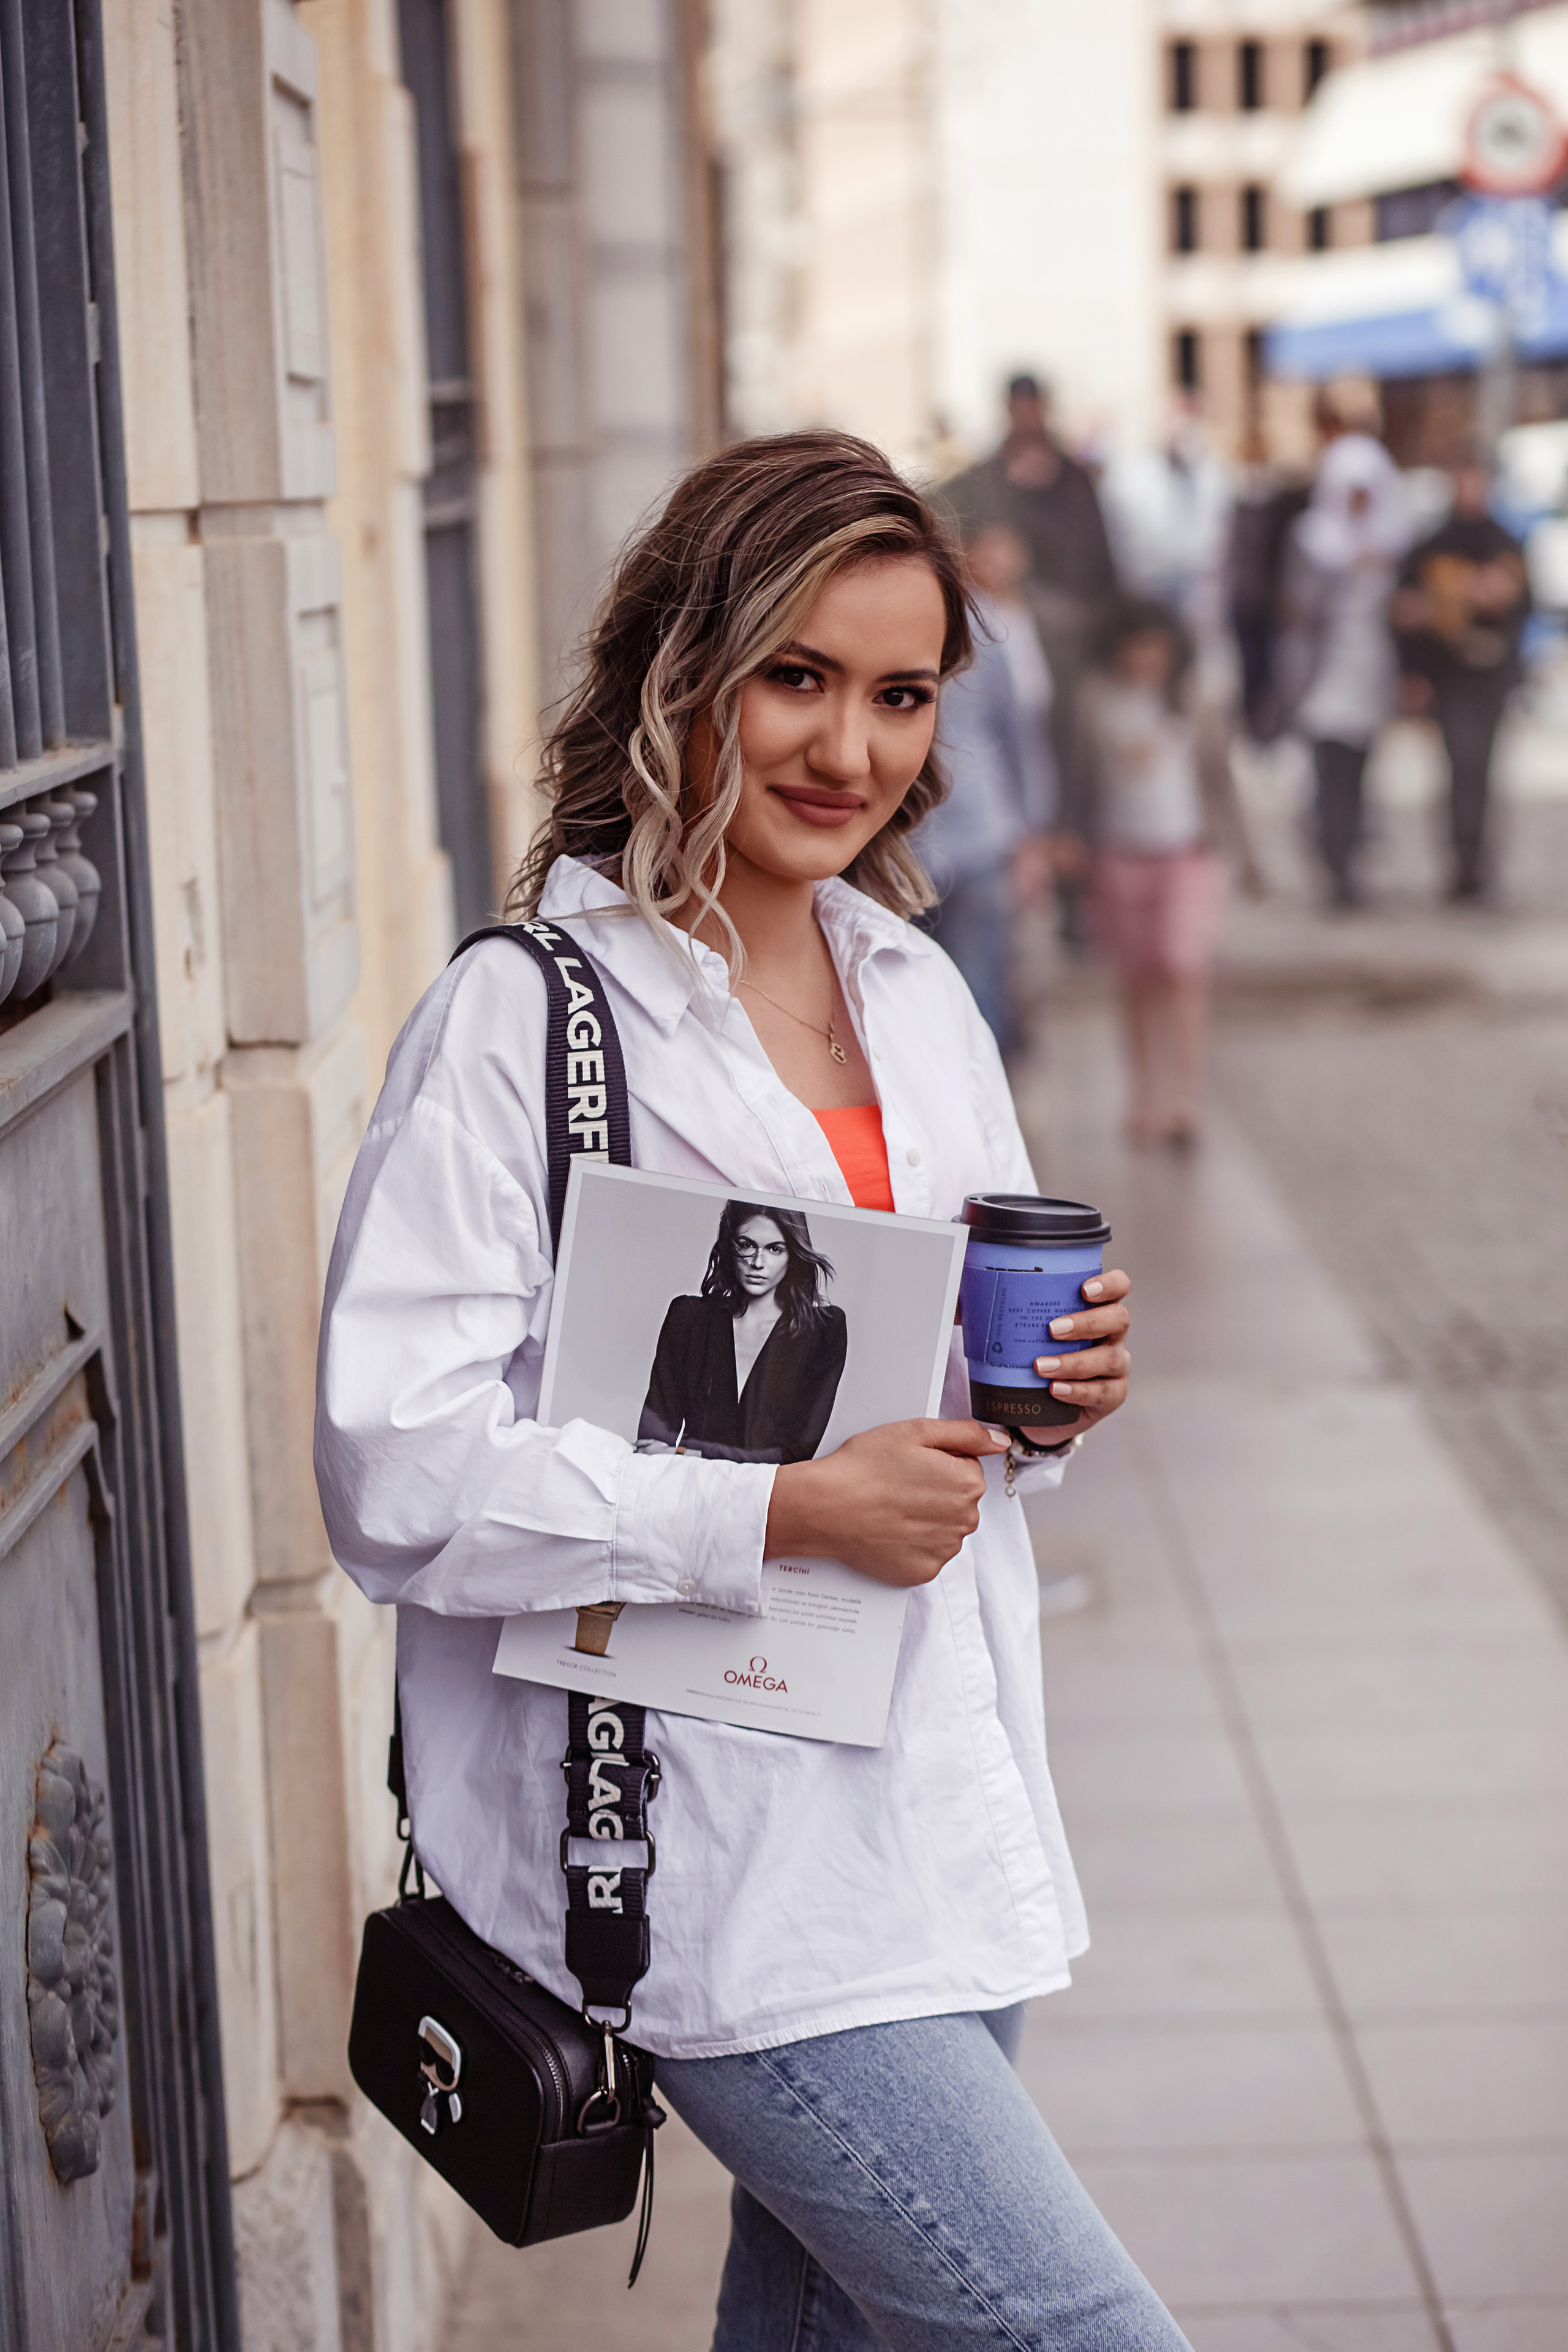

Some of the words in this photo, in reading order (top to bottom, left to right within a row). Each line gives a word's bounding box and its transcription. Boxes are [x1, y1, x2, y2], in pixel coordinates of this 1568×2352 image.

[986, 1400, 1041, 1414] ESPRESSO
[579, 1665, 616, 1677] COLLECTION
[724, 1670, 788, 1693] OMEGA
